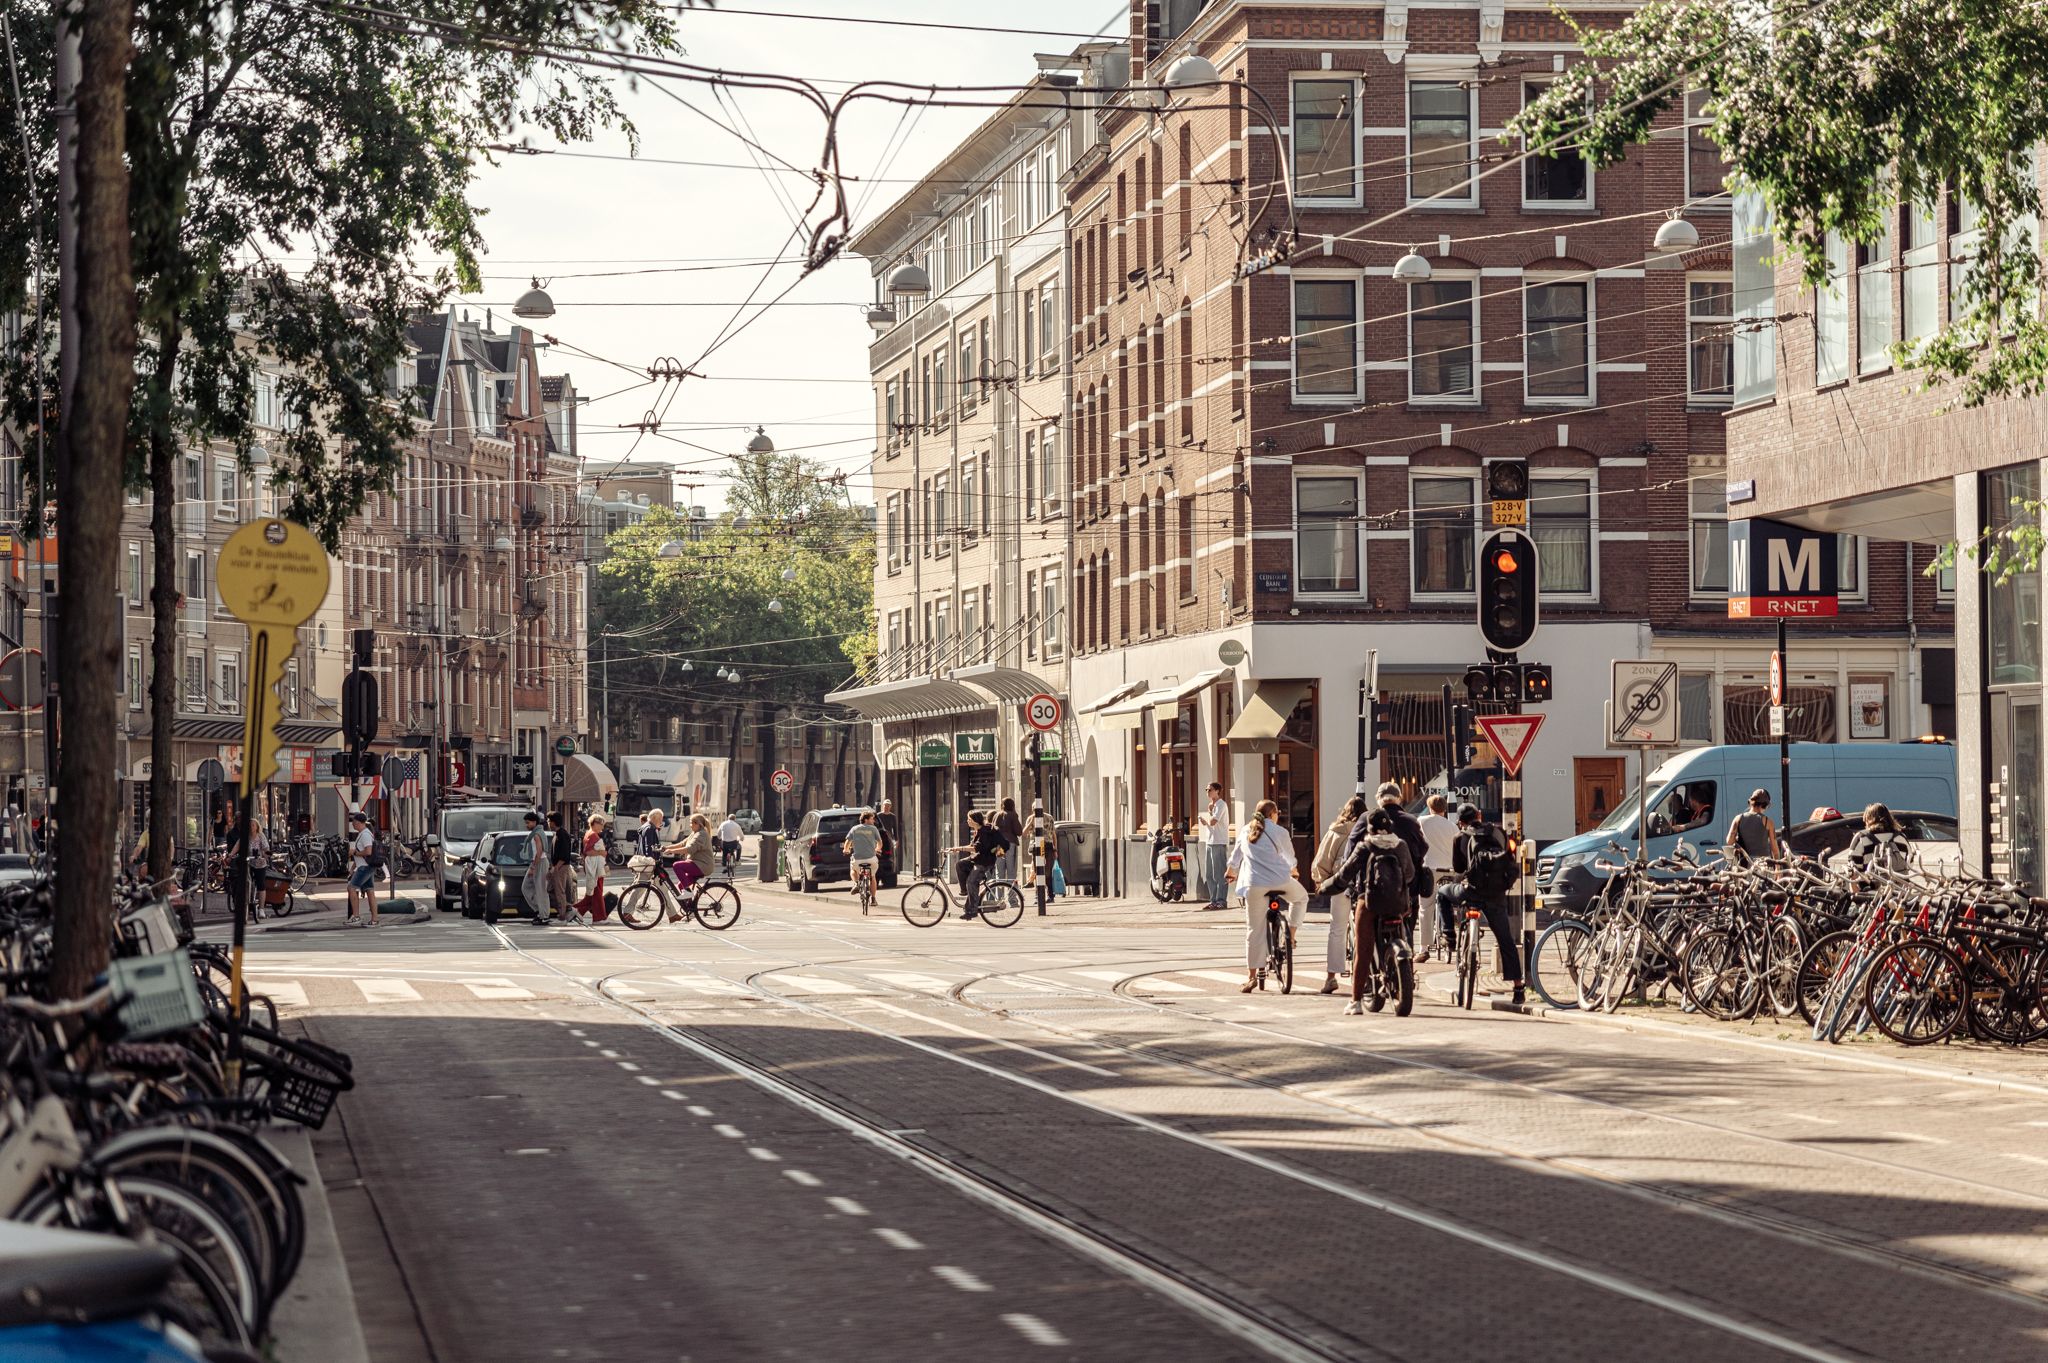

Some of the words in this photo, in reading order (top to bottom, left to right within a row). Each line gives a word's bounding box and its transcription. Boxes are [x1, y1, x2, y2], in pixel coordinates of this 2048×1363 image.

[1495, 502, 1522, 511] 328-V
[1495, 514, 1522, 523] 327-V
[1733, 539, 1746, 592] M
[1768, 538, 1820, 592] M
[1632, 666, 1659, 675] ZONE
[1631, 693, 1660, 711] 30
[1034, 705, 1055, 719] 30
[958, 753, 994, 761] MEPHISTO
[776, 777, 789, 786] 30
